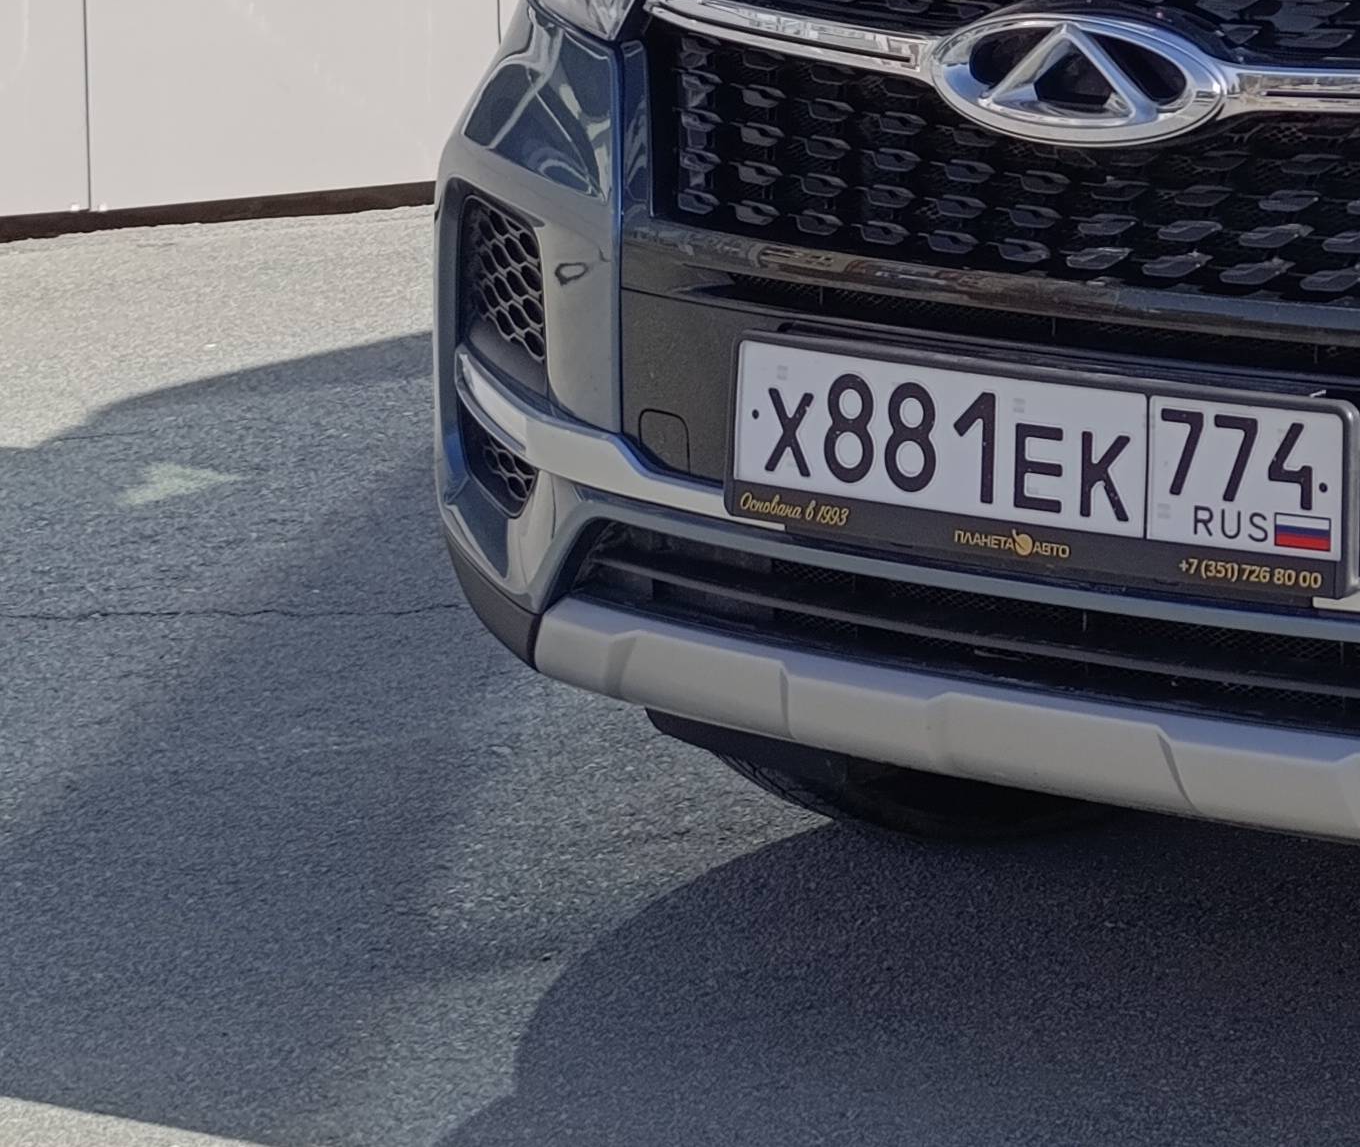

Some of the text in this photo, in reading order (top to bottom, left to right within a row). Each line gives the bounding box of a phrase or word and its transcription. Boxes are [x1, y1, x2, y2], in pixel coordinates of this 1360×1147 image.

[1159, 407, 1314, 511] 774
[740, 492, 849, 526] Основана в 1993
[1193, 505, 1268, 543] RUS
[954, 529, 1070, 558] ПЛАНЕТА АВТО
[1179, 558, 1322, 588] +7 (351) 726 80 00
